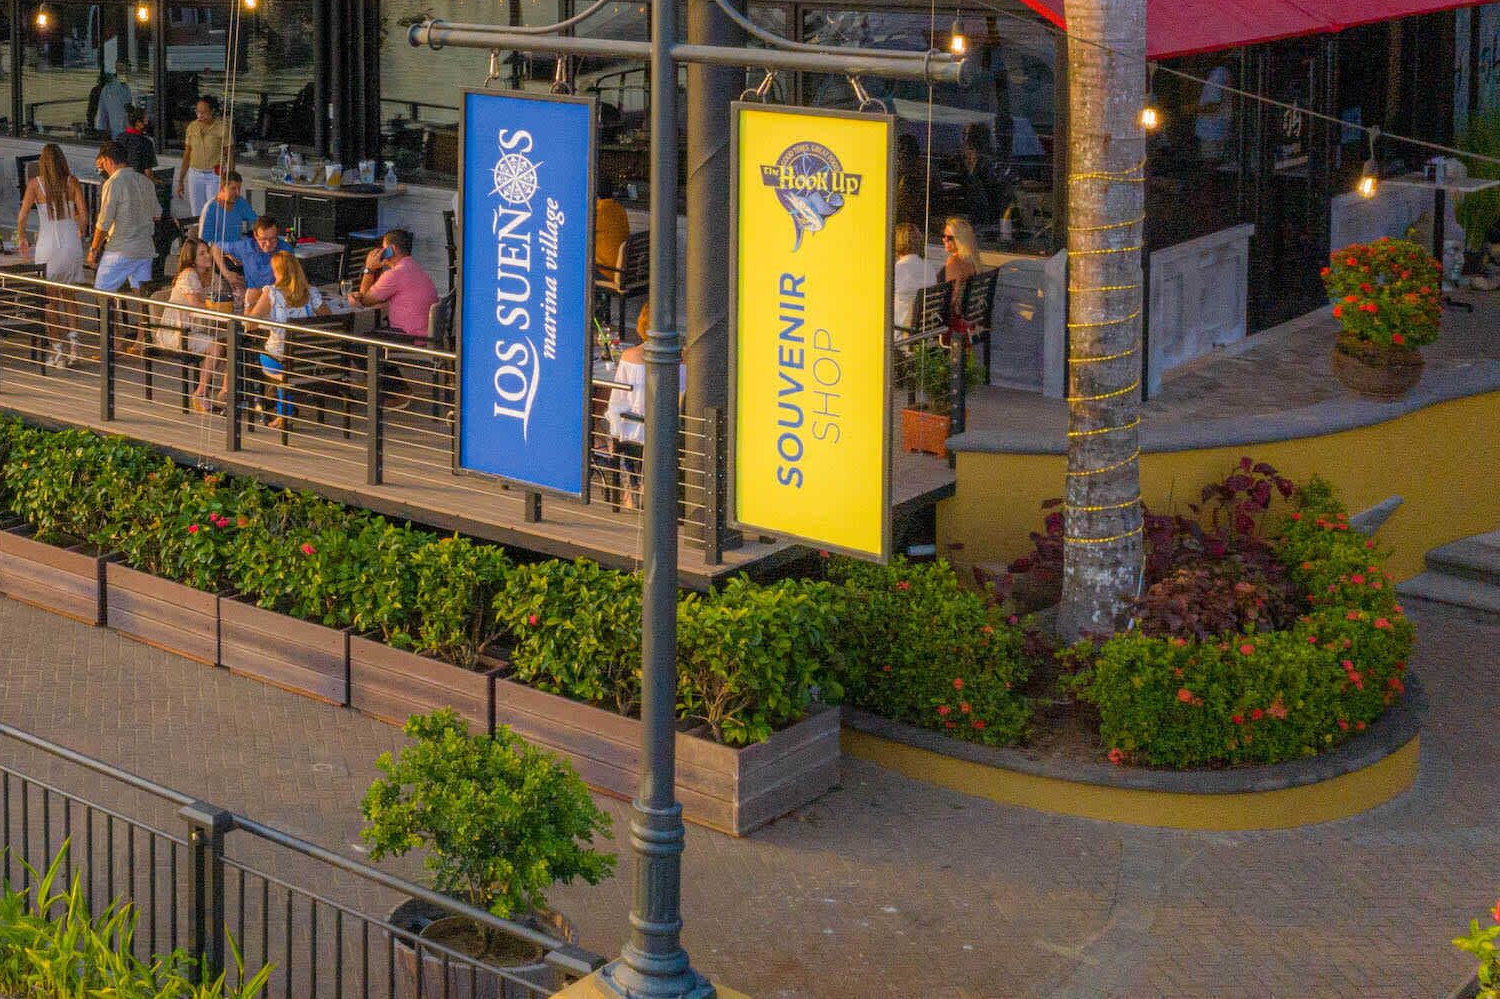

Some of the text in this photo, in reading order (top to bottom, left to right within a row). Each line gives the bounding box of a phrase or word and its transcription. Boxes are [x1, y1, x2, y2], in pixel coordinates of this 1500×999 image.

[538, 197, 565, 361] marina village
[493, 336, 540, 444] LOS
[776, 272, 842, 489] SOUVENIR SHOP
